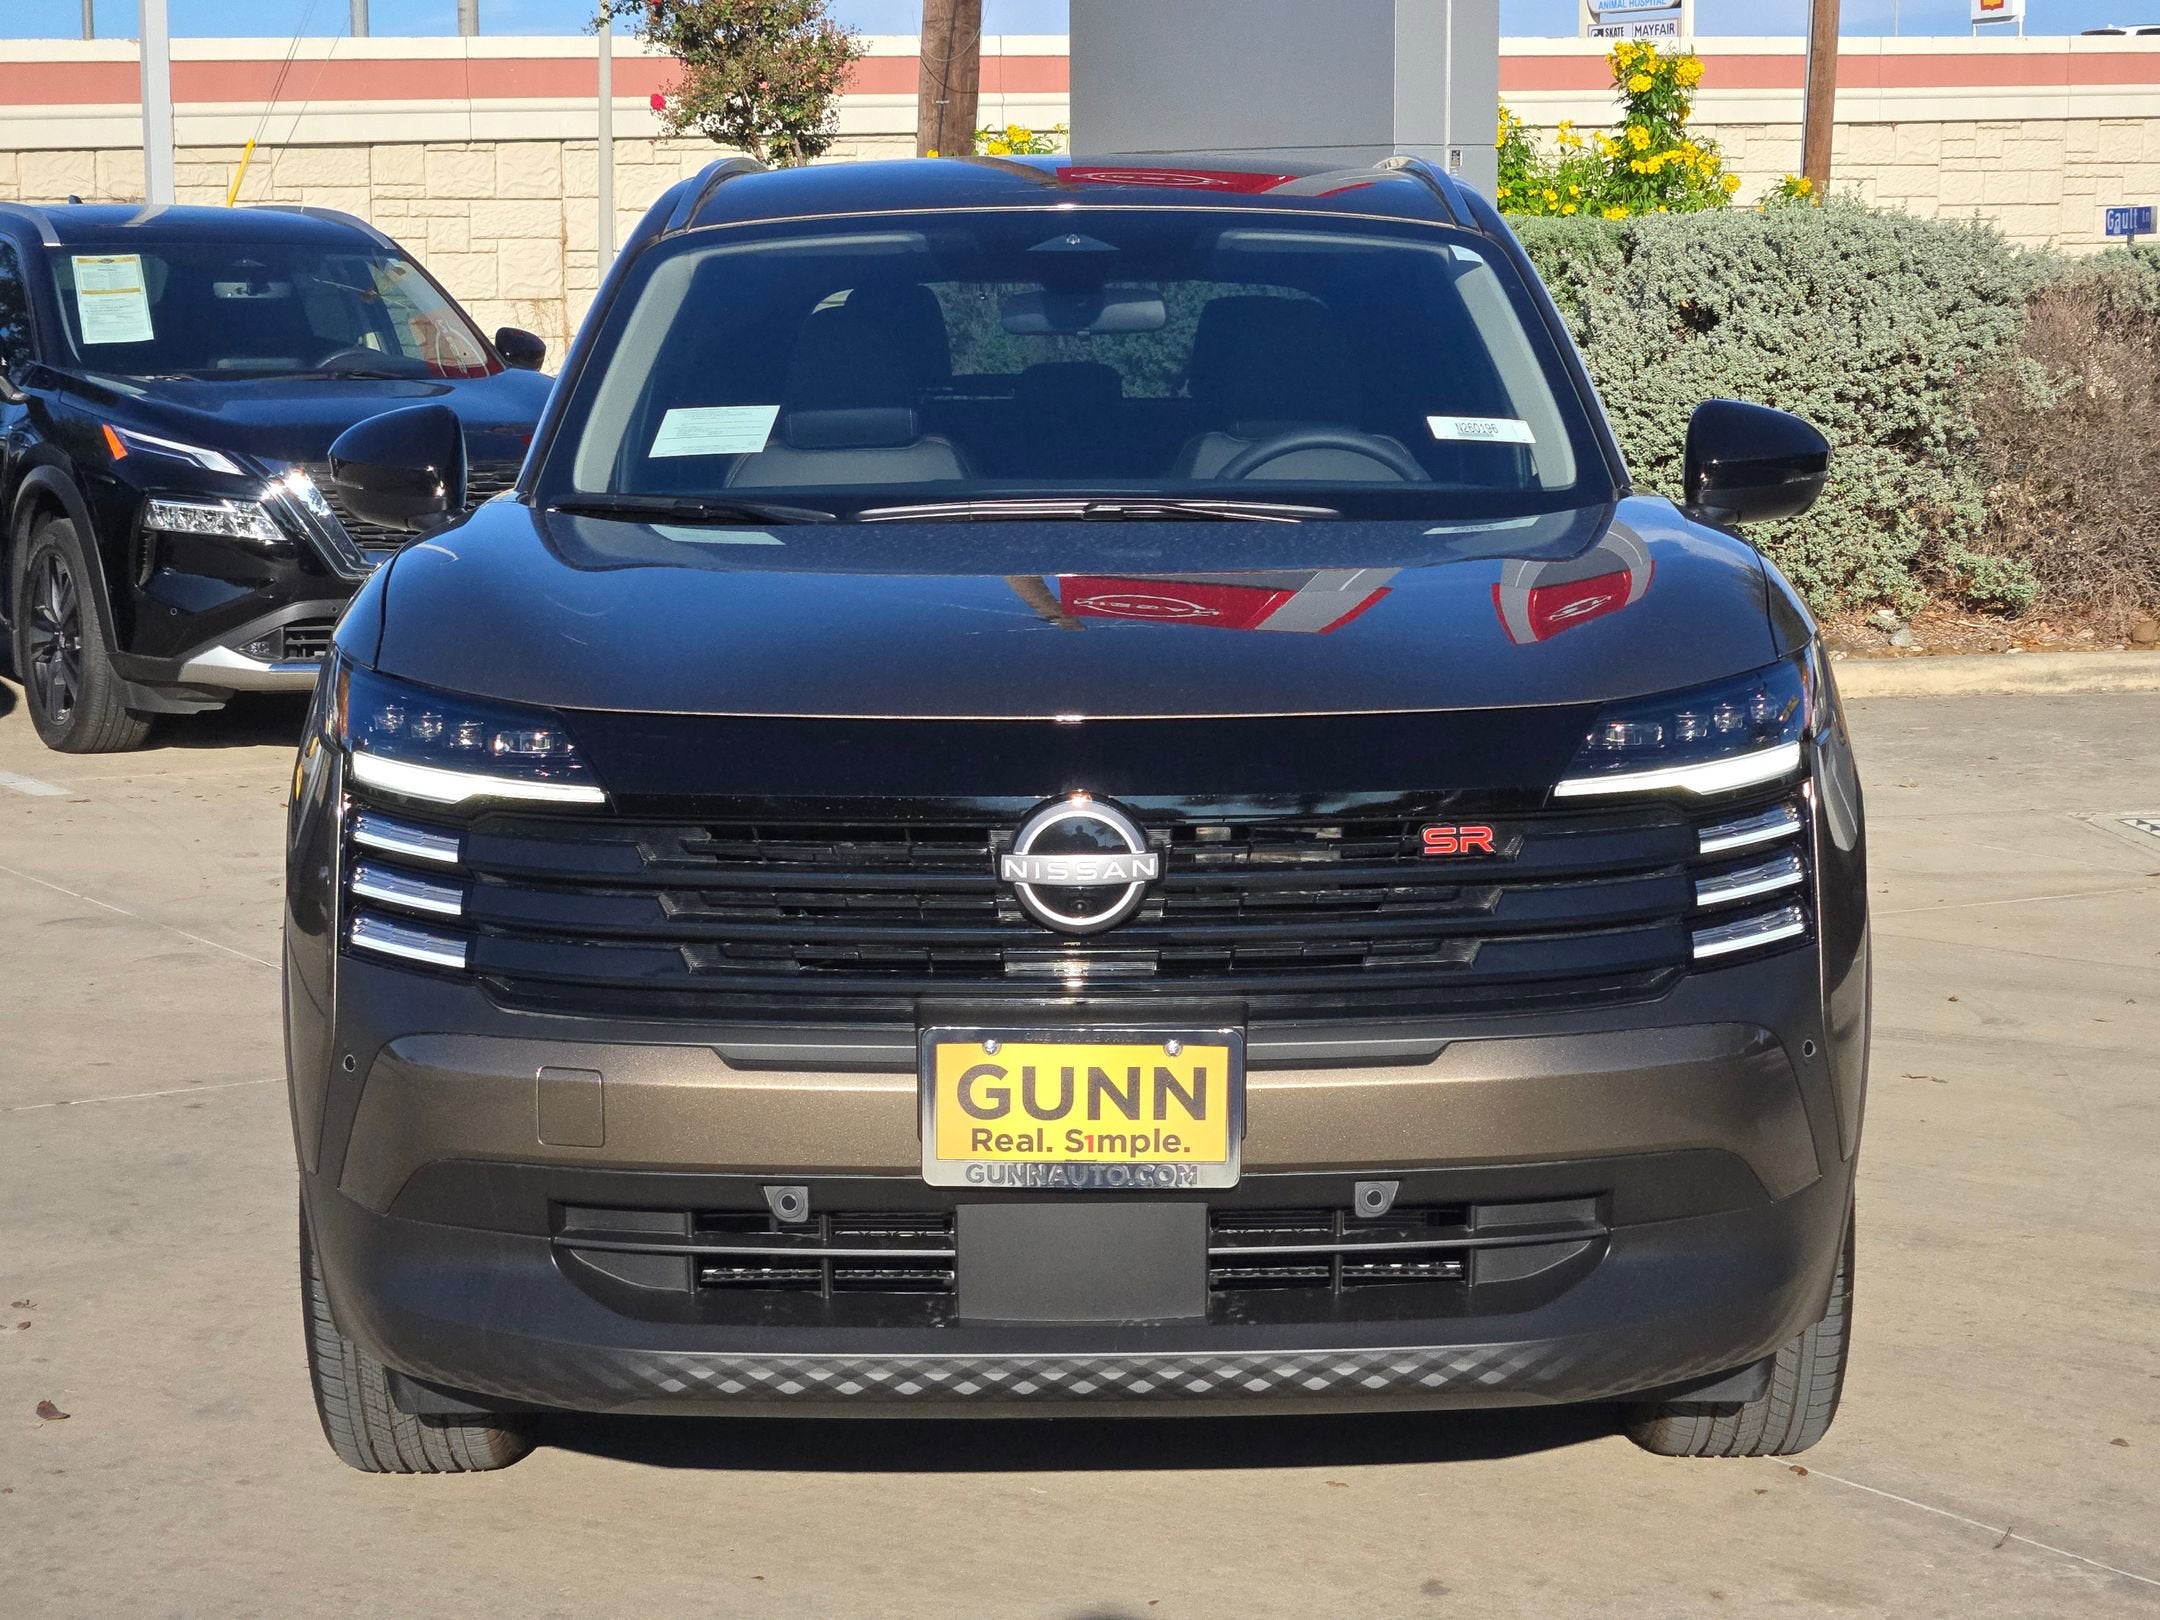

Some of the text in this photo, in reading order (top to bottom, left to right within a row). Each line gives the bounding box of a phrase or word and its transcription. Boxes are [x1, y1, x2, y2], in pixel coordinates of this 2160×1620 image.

[1598, 0, 1627, 10] ANIMAL
[1605, 26, 1625, 37] SKATE
[1634, 23, 1675, 37] MAYFAIR
[2107, 208, 2138, 230] Gault
[1423, 826, 1494, 854] SR
[1004, 857, 1155, 881] NISSAN
[957, 1063, 1207, 1121] GUNN
[971, 1128, 1053, 1153] Real.
[965, 1163, 1198, 1188] GUNNAUTO.COM
